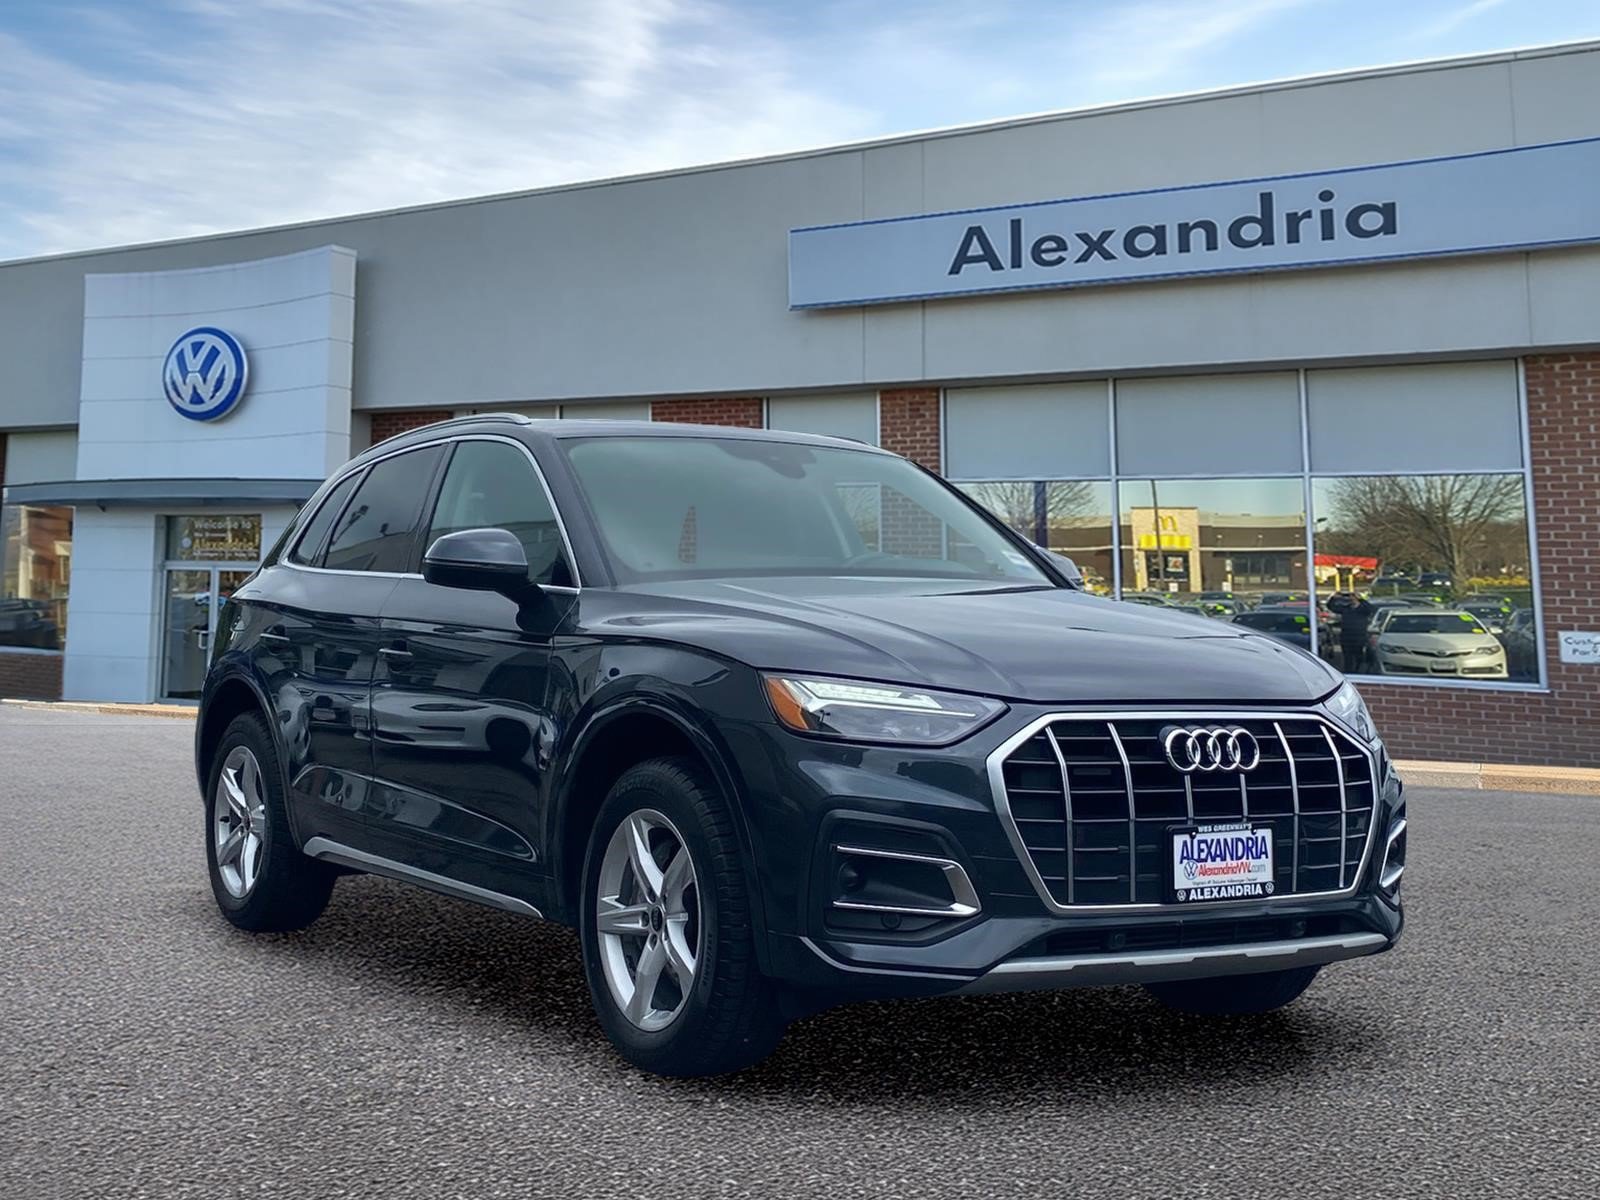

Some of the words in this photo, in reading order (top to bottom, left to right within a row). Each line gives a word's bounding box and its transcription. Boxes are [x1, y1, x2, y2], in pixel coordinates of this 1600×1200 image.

[947, 189, 1398, 276] Alexandria
[1180, 835, 1268, 864] ALEXANDRIA
[1189, 883, 1263, 901] ALEXANDRIA
